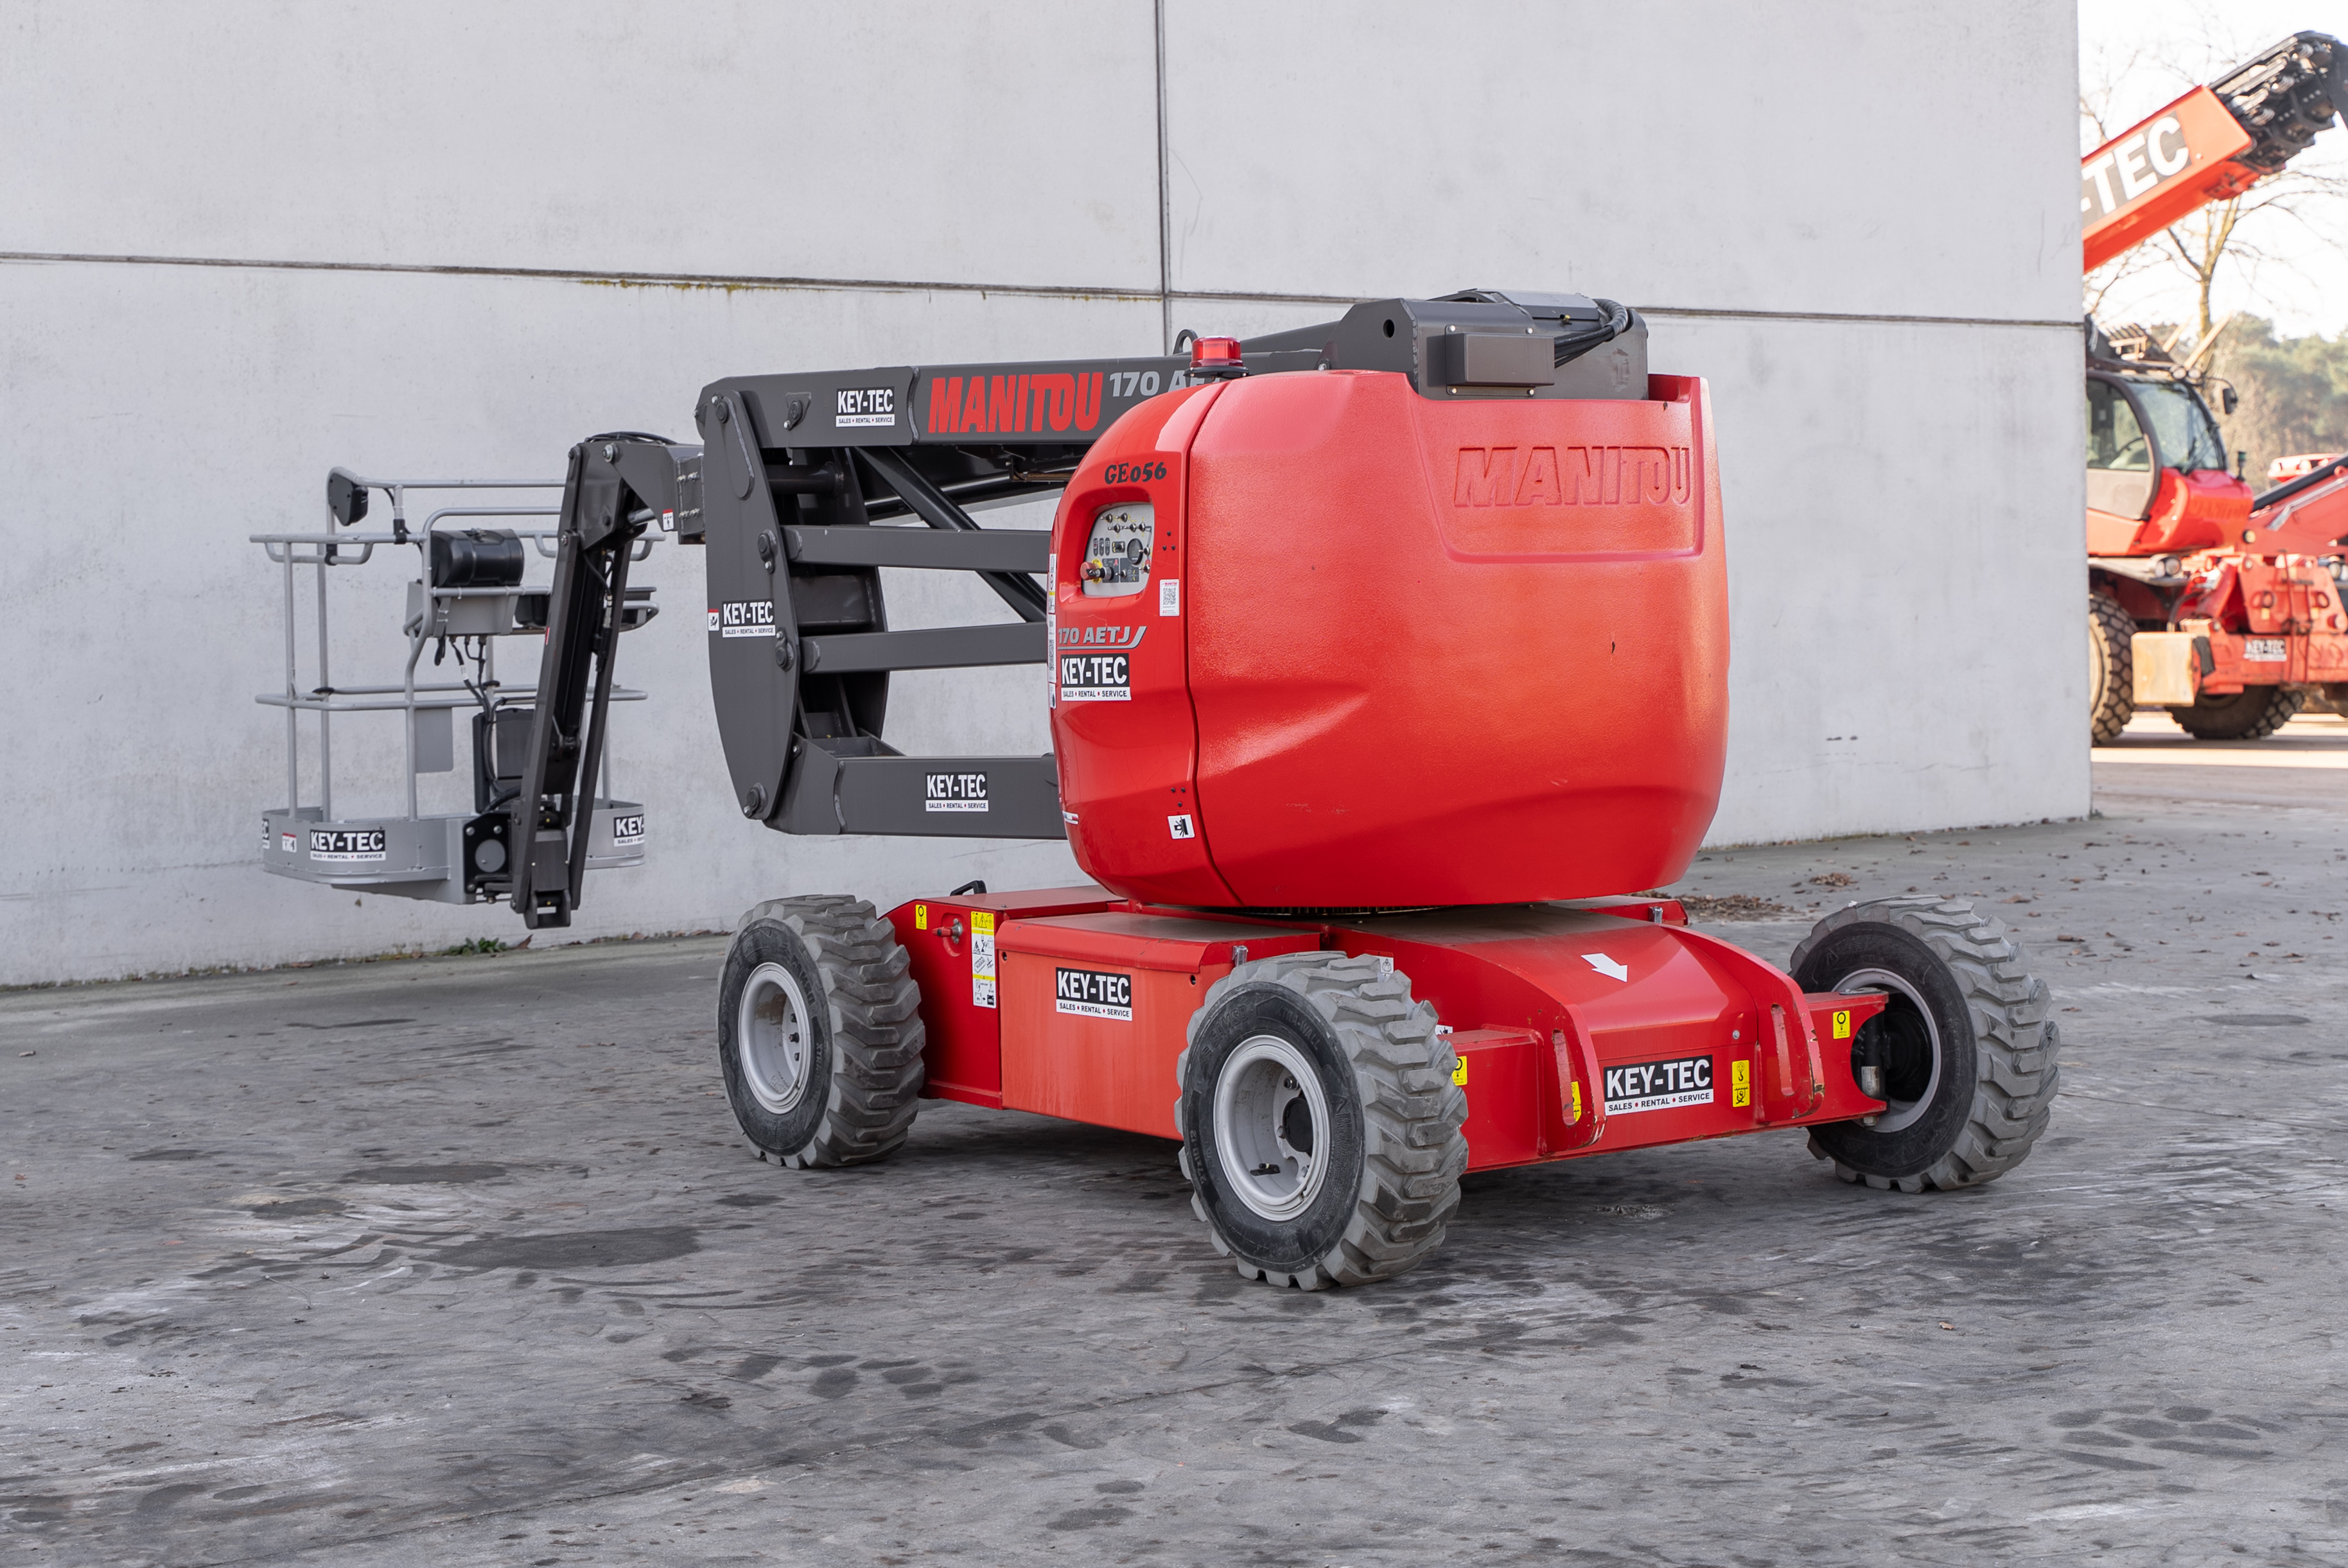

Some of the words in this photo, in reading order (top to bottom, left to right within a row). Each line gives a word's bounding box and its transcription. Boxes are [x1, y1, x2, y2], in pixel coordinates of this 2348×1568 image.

[837, 388, 893, 414] KEY-TEC
[927, 372, 1104, 433] MANITOU
[1109, 370, 1161, 397] 170
[1453, 446, 1691, 508] MANITOU
[723, 601, 774, 625] KEY-TEC
[1058, 627, 1080, 645] 170
[1083, 625, 1131, 644] AETJ
[1061, 656, 1128, 685] KEY-TEC
[927, 774, 986, 797] KEY-TEC
[311, 831, 383, 851] KEY-TEC
[1057, 970, 1130, 1004] KEY-TEC
[1059, 1002, 1076, 1011] SALES
[1081, 1005, 1101, 1014] RENTAL
[1107, 1008, 1130, 1017] SERVICE
[1607, 1059, 1710, 1099] KEY-TEC
[1608, 1102, 1633, 1111] SALES
[1641, 1097, 1670, 1108] RENTAL
[1678, 1092, 1710, 1103] SERVICE
